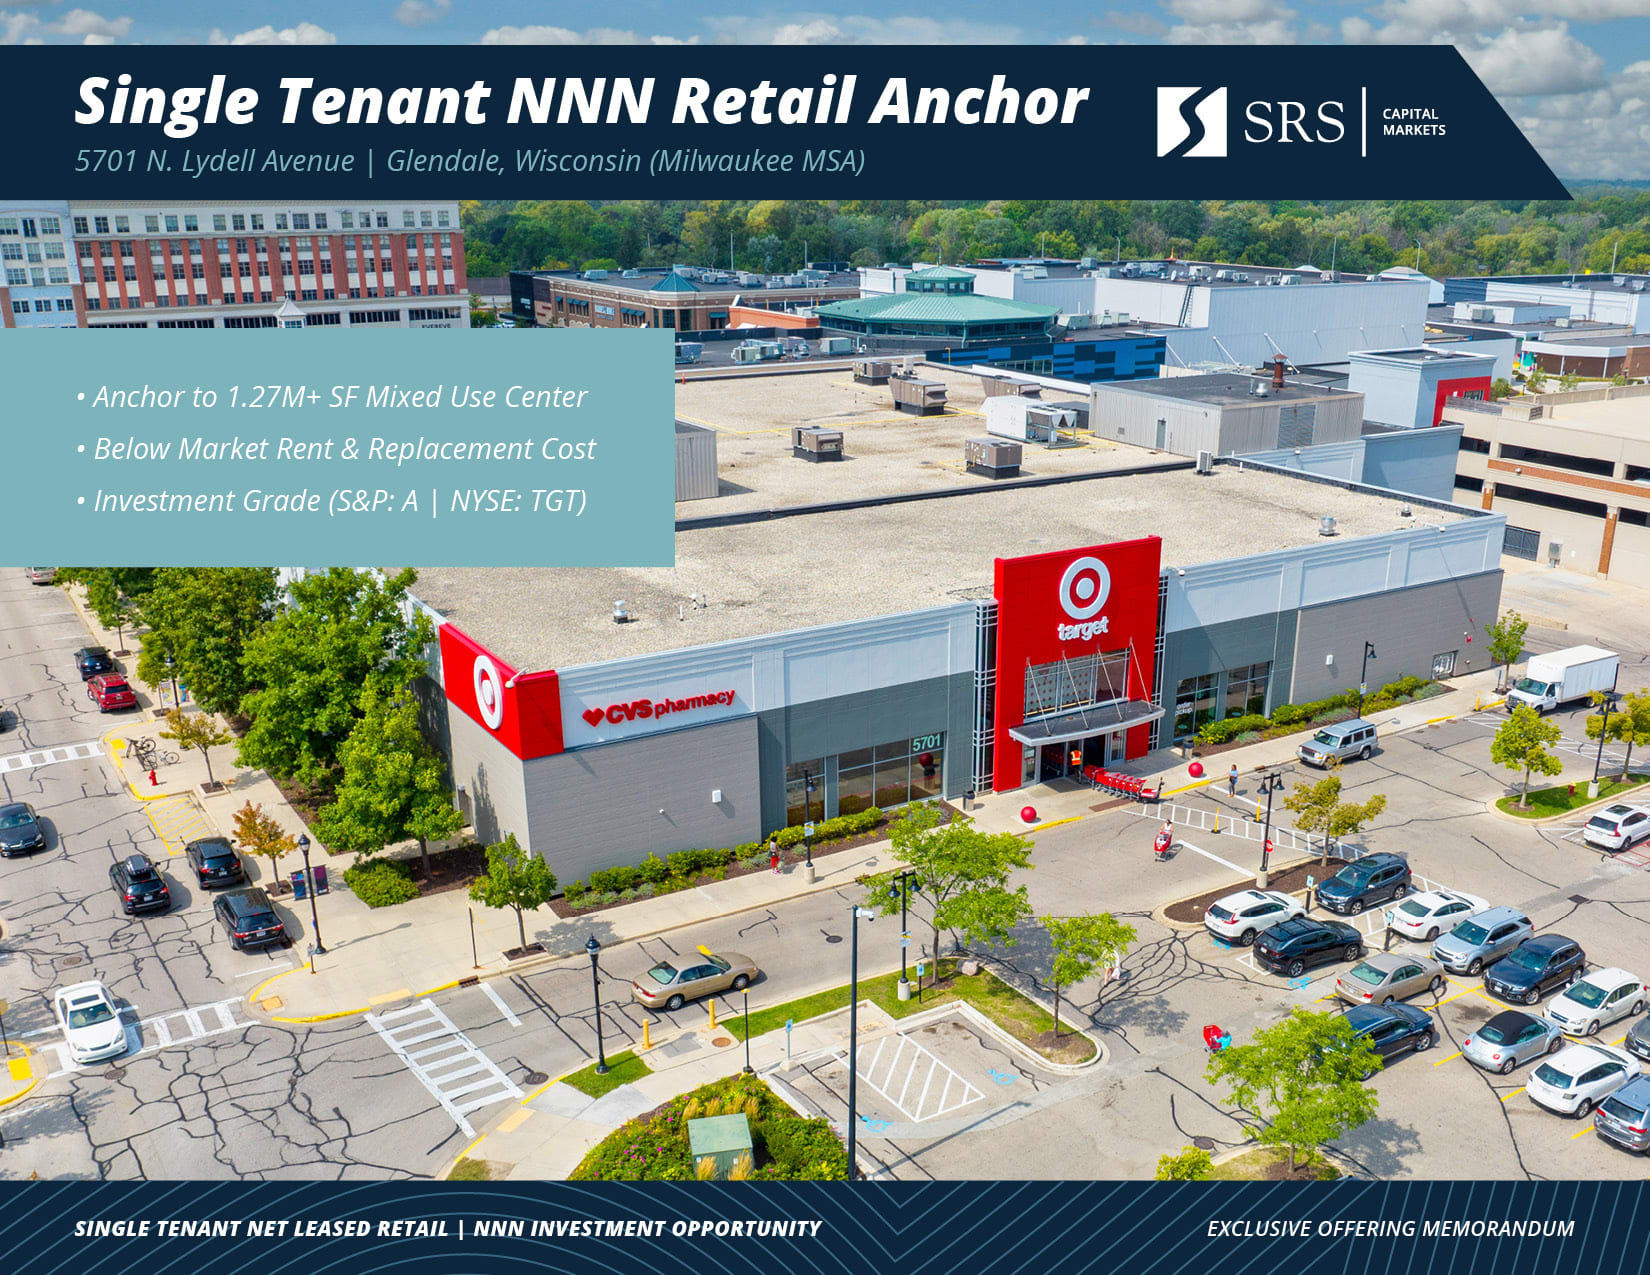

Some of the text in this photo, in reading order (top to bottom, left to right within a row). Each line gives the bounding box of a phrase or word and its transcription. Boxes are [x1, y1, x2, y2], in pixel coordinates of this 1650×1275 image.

[1057, 615, 1109, 641] target
[605, 690, 736, 724] CVS pharmacy
[912, 733, 941, 752] 5701
